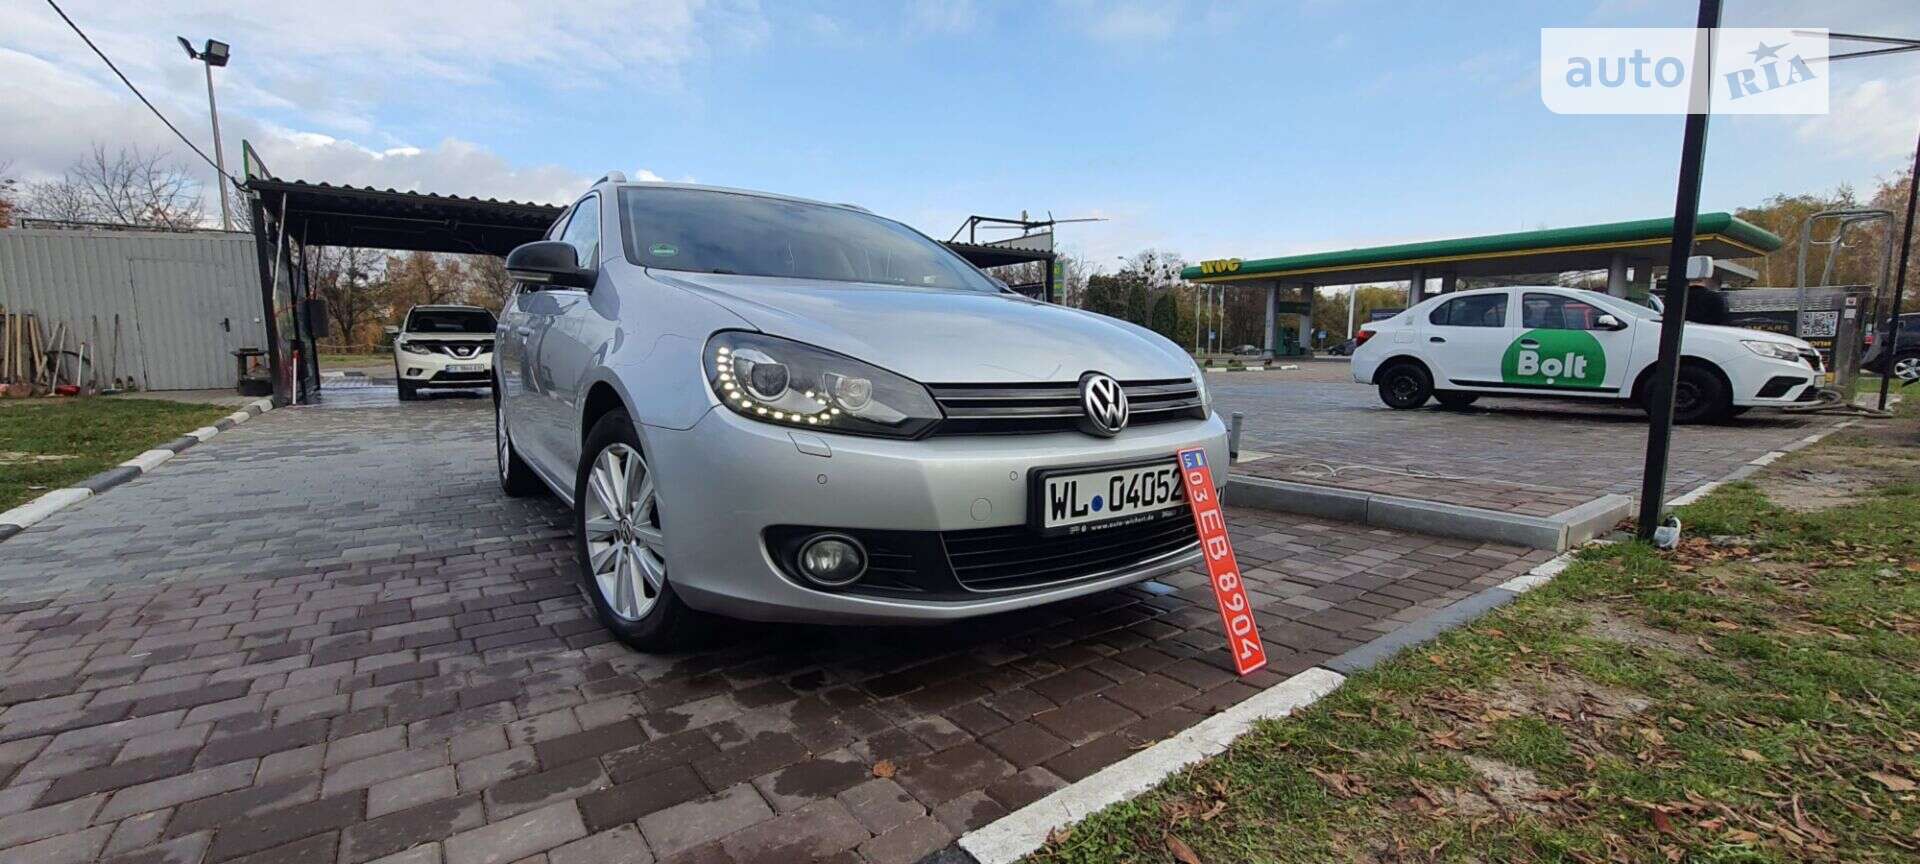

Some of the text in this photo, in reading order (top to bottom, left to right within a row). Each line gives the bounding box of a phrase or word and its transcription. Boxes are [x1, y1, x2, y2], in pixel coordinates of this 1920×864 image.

[1200, 257, 1241, 273] WOG
[1517, 350, 1587, 383] Bolt
[1050, 469, 1182, 520] WL 04052
[1184, 453, 1260, 660] UA 03 EB 8904
